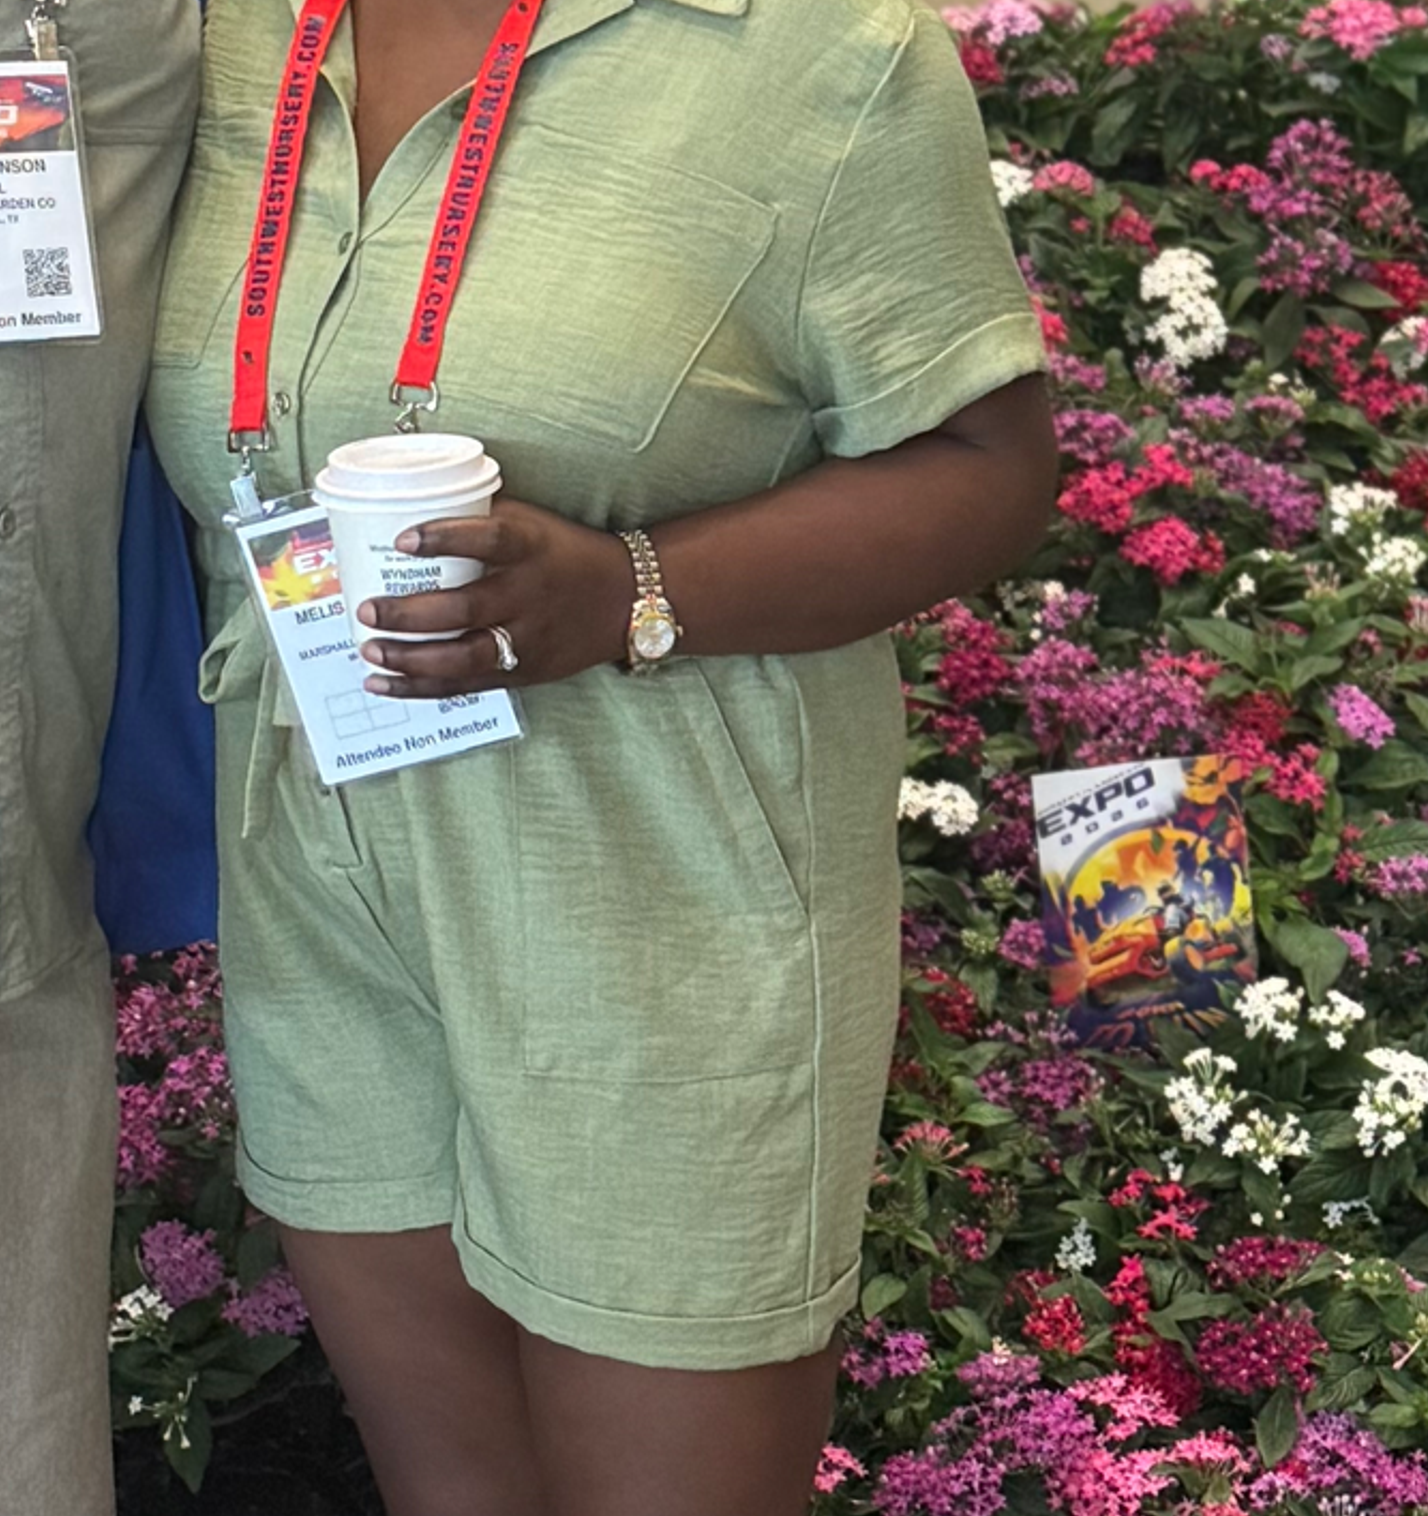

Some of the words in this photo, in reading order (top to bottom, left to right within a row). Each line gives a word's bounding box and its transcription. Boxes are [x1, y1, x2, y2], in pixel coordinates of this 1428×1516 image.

[37, 196, 56, 209] CO
[21, 310, 82, 326] Member
[294, 600, 345, 625] MELIS
[335, 742, 402, 769] Attendee
[403, 734, 437, 751] Non
[438, 717, 500, 742] Member
[1037, 767, 1156, 839] EXPO
